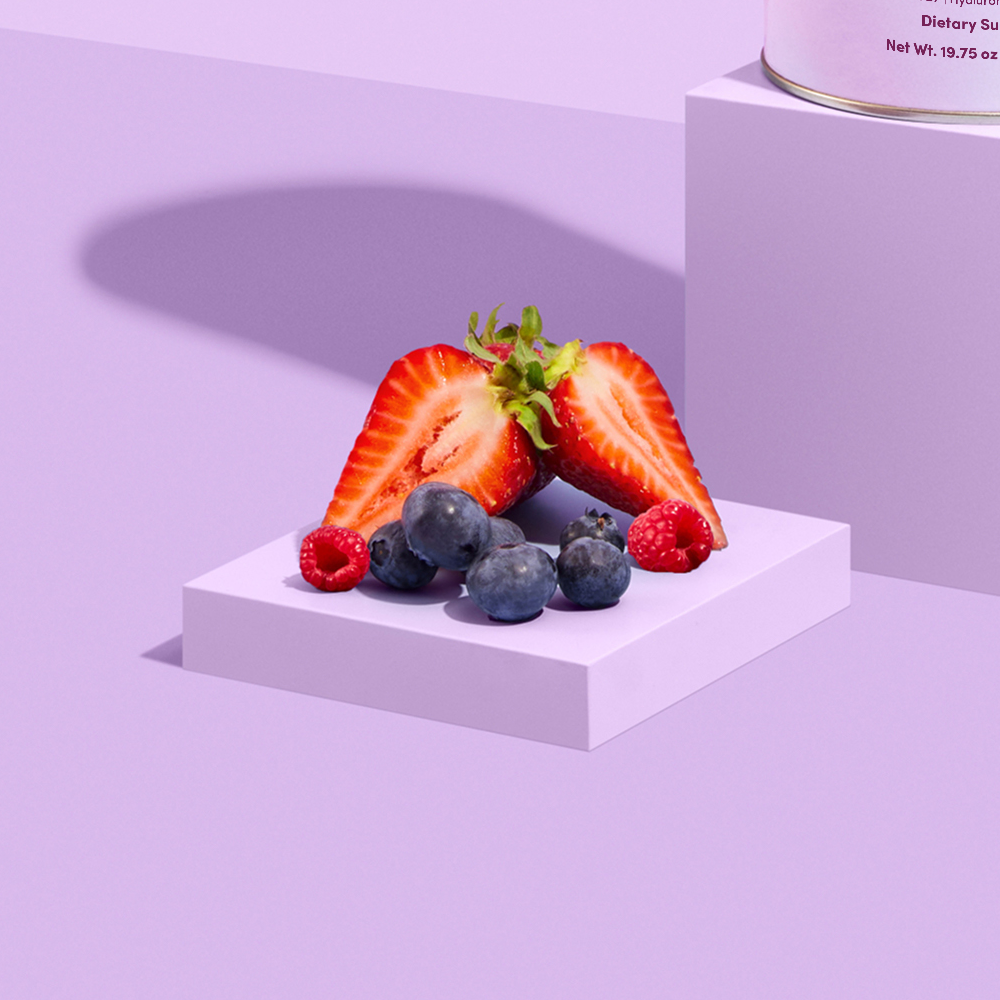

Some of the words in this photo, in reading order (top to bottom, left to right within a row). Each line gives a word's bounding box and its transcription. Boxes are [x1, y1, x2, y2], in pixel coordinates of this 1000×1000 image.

[921, 14, 977, 34] Dietary
[886, 38, 911, 54] Net
[913, 42, 937, 57] Wt.
[940, 46, 978, 60] 19.75
[980, 50, 999, 60] oz
